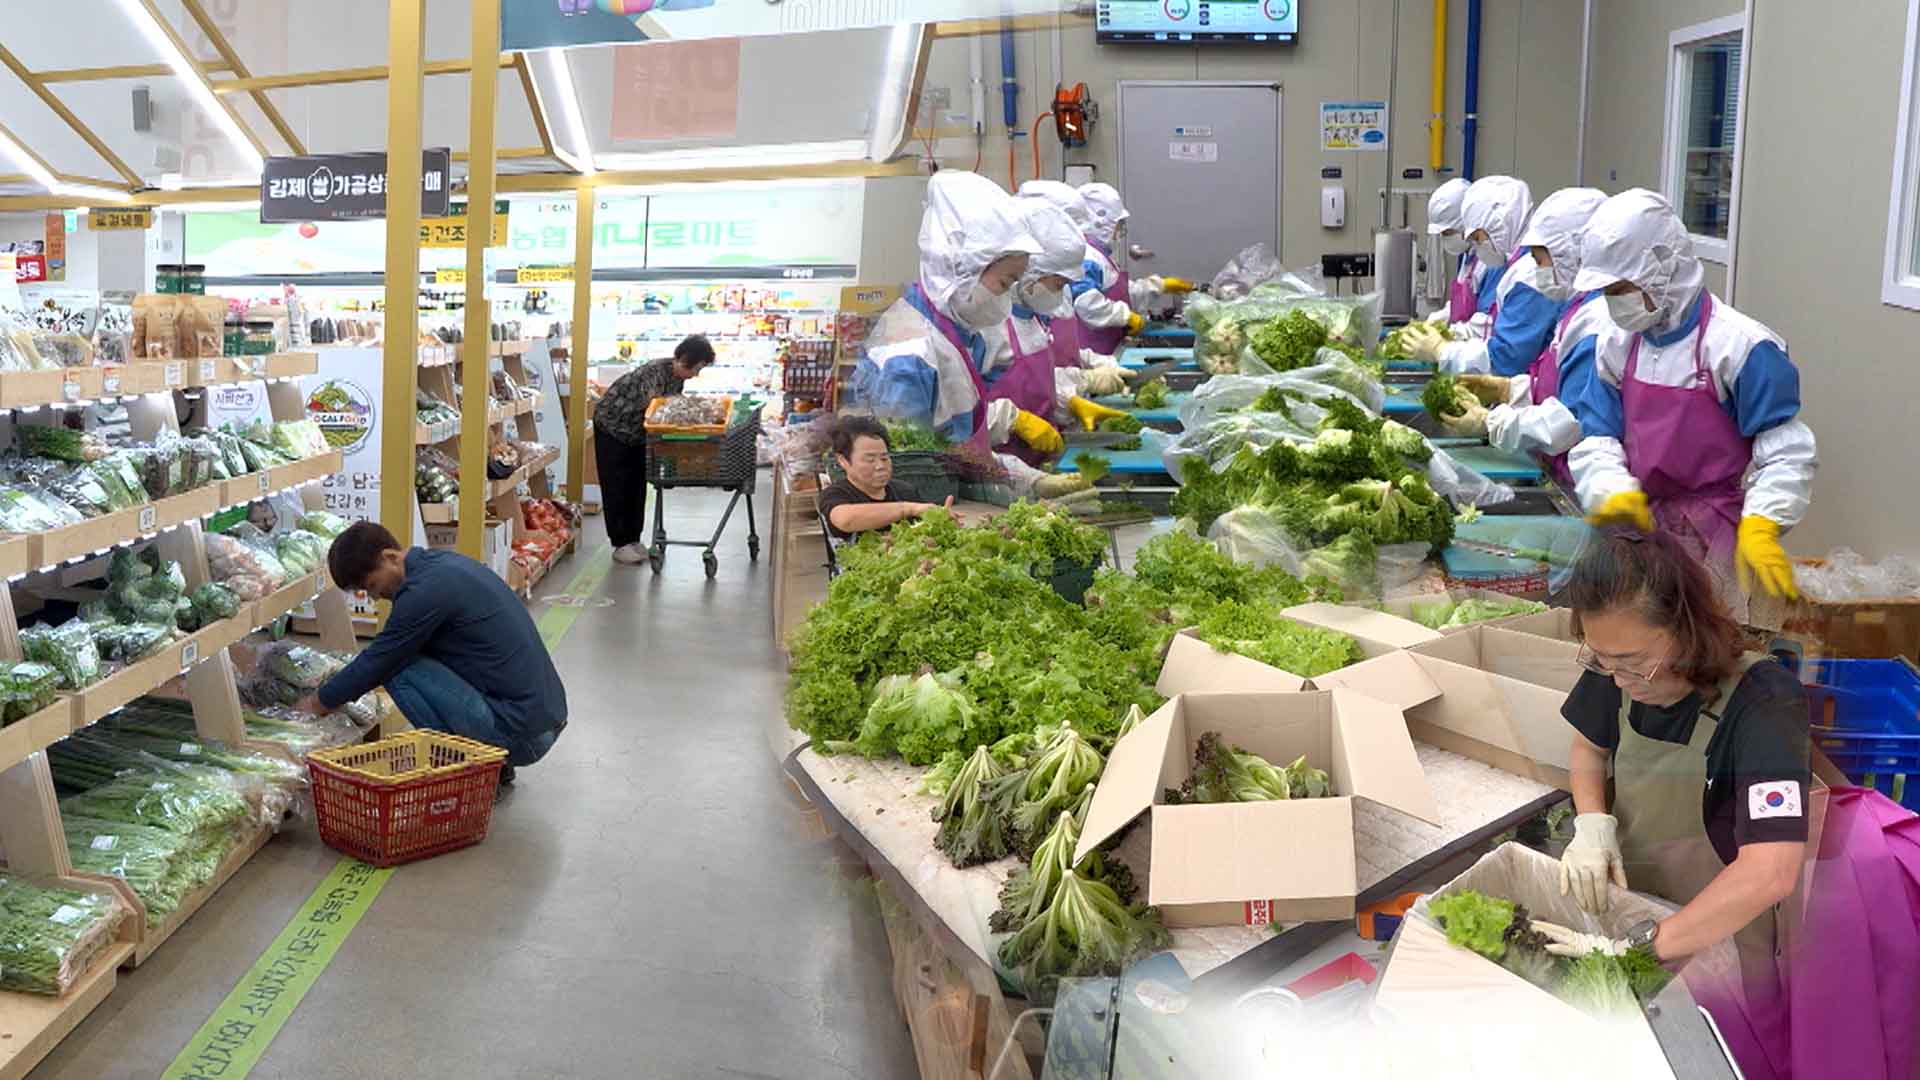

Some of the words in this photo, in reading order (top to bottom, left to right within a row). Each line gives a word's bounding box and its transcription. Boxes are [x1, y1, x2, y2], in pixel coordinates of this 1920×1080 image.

[269, 177, 306, 198] 김제
[312, 177, 329, 196] 쌀
[333, 172, 388, 196] 가공상
[314, 415, 338, 424] OCAL
